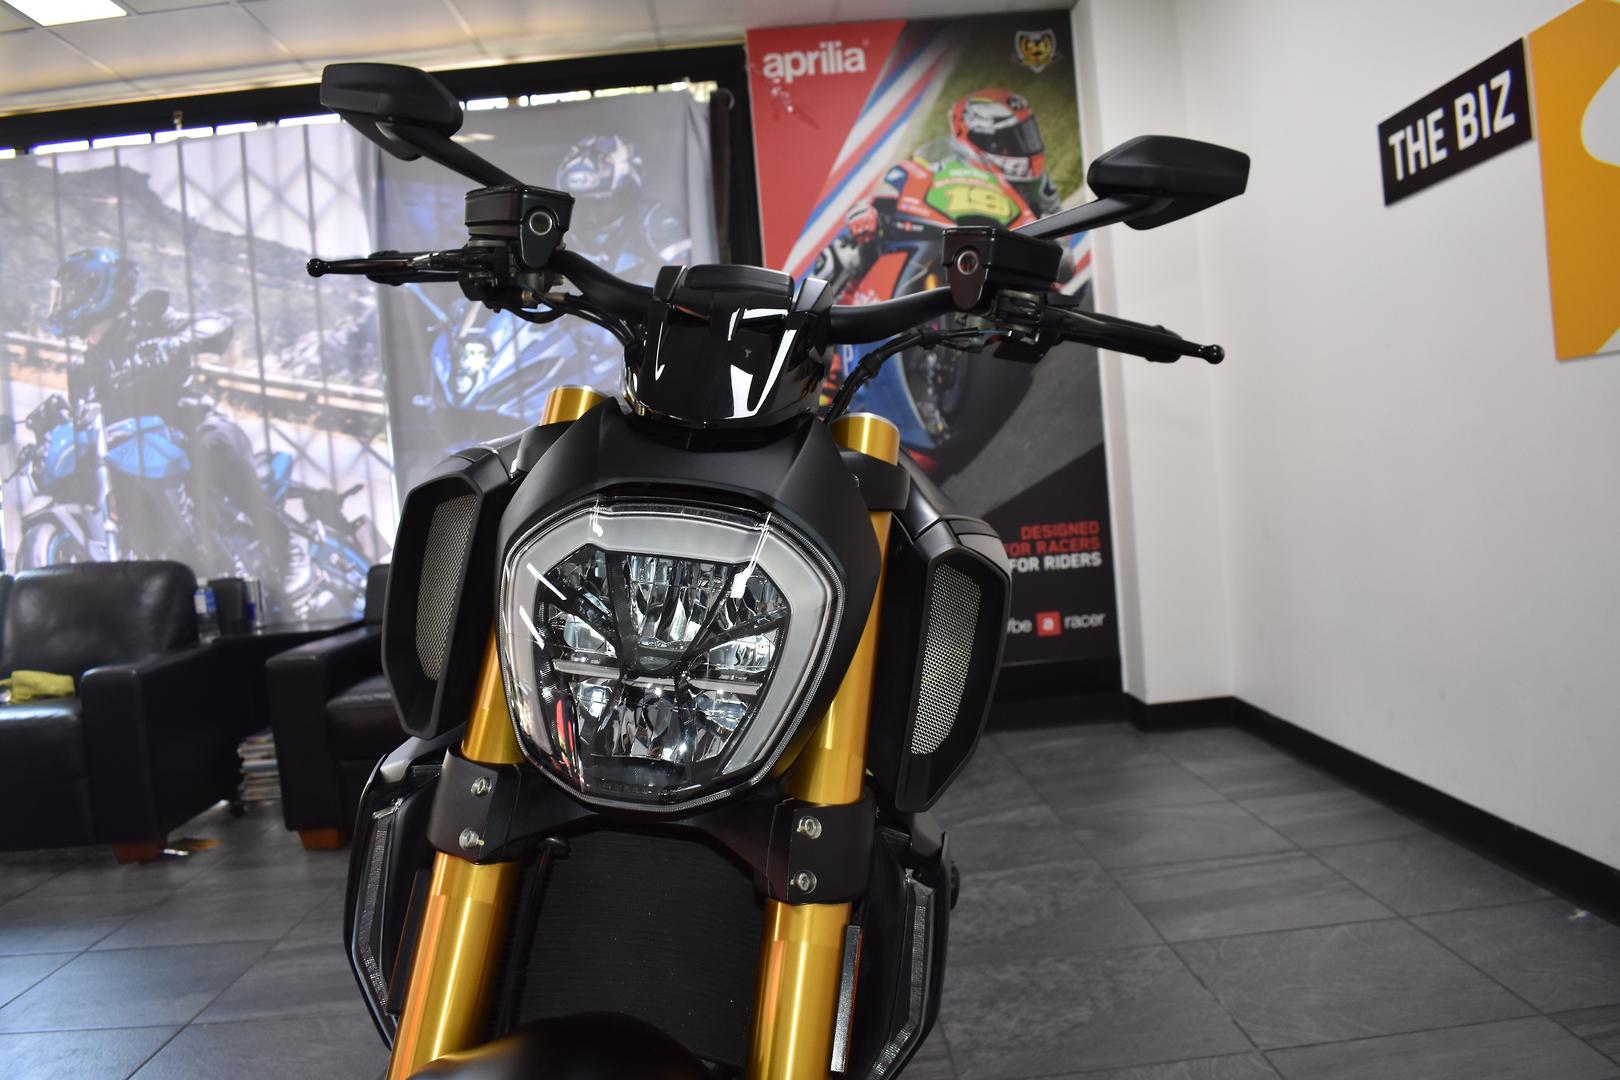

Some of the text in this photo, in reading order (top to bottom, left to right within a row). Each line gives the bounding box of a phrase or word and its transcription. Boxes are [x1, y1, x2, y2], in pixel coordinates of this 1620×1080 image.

[763, 40, 866, 84] aprilia
[1388, 69, 1516, 181] THE BIZ
[1021, 521, 1099, 540] DESIGNED
[1036, 538, 1099, 554] RACERS
[1044, 552, 1102, 570] RIDERS
[1064, 613, 1105, 629] racer
